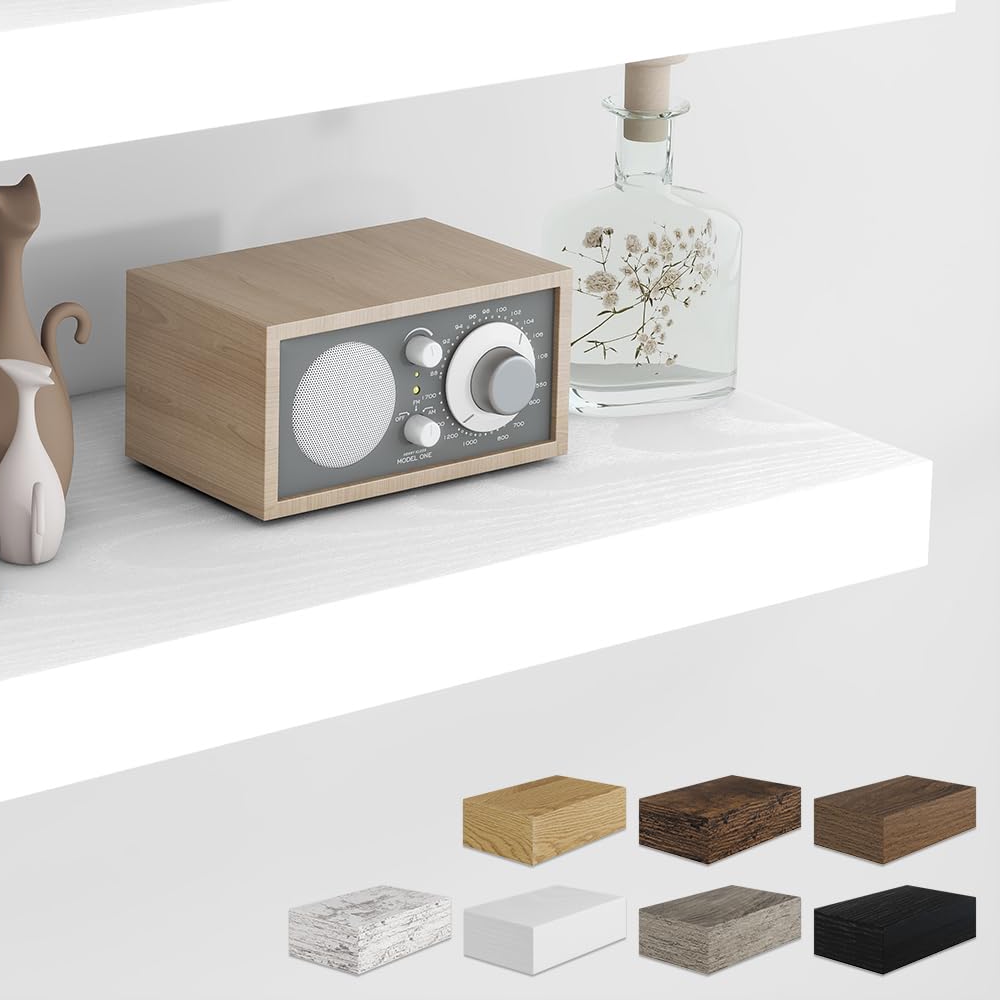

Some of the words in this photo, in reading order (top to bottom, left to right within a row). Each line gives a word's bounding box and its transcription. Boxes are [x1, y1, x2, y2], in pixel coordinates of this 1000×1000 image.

[462, 439, 478, 447] 1000
[396, 455, 418, 464] MODEL
[419, 451, 433, 460] ONE
